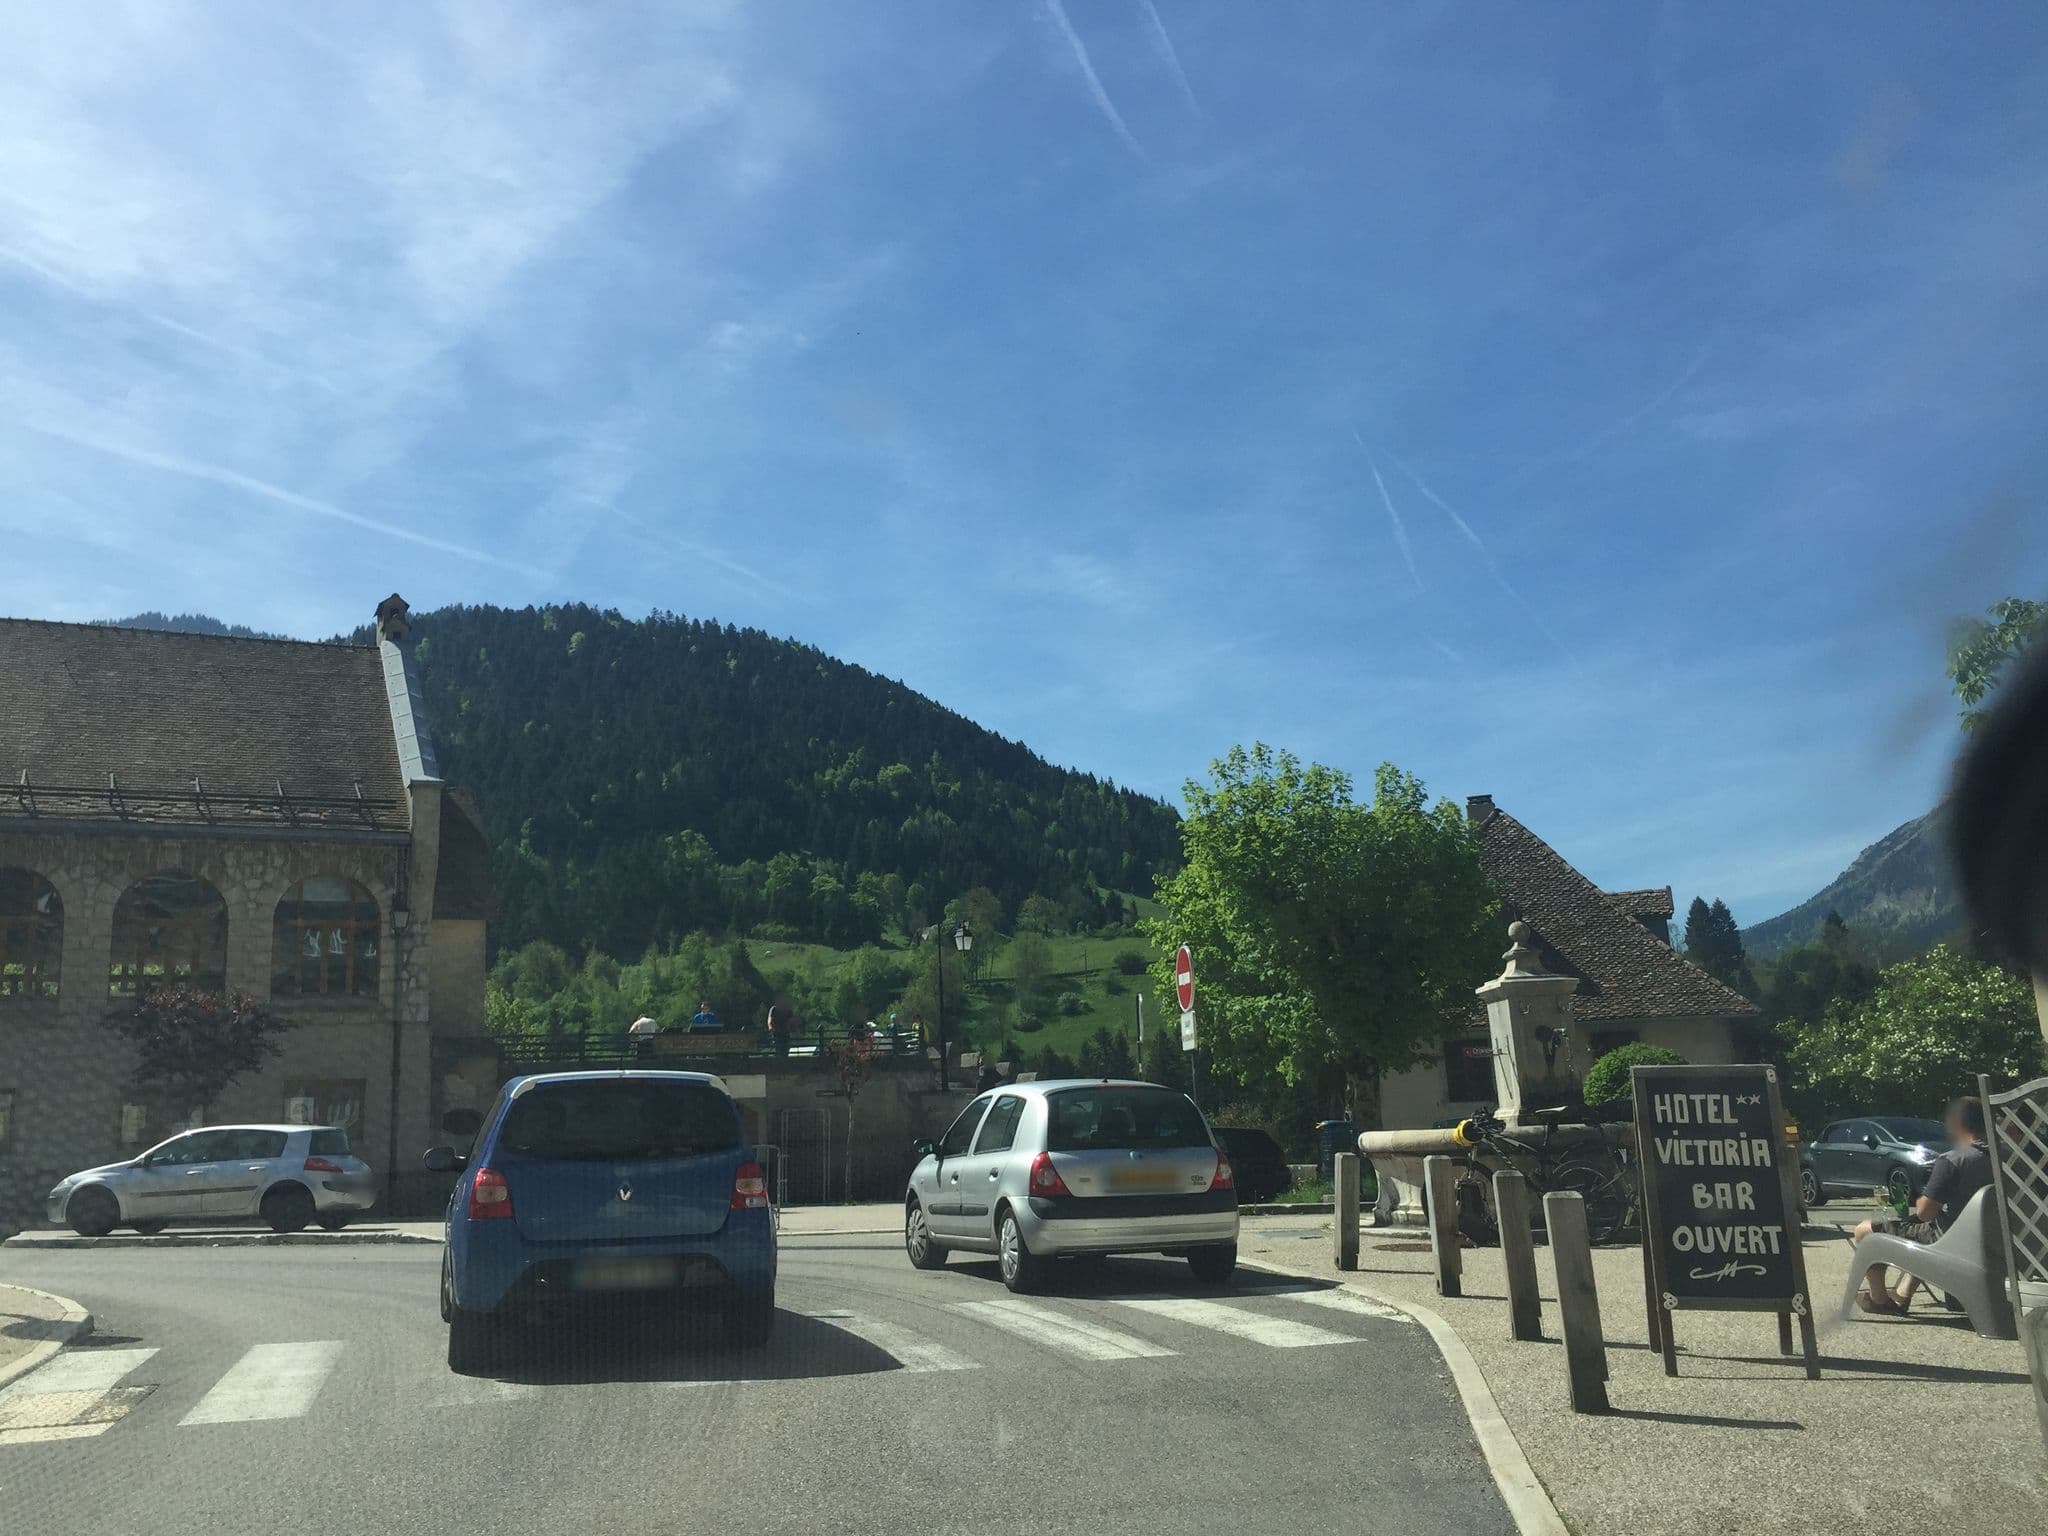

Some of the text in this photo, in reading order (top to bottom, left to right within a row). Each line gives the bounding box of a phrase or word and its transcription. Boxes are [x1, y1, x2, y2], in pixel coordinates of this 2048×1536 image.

[1654, 1093, 1739, 1124] HOTEL
[1692, 1181, 1756, 1211] BAR
[1672, 1225, 1782, 1254] OUVERT
